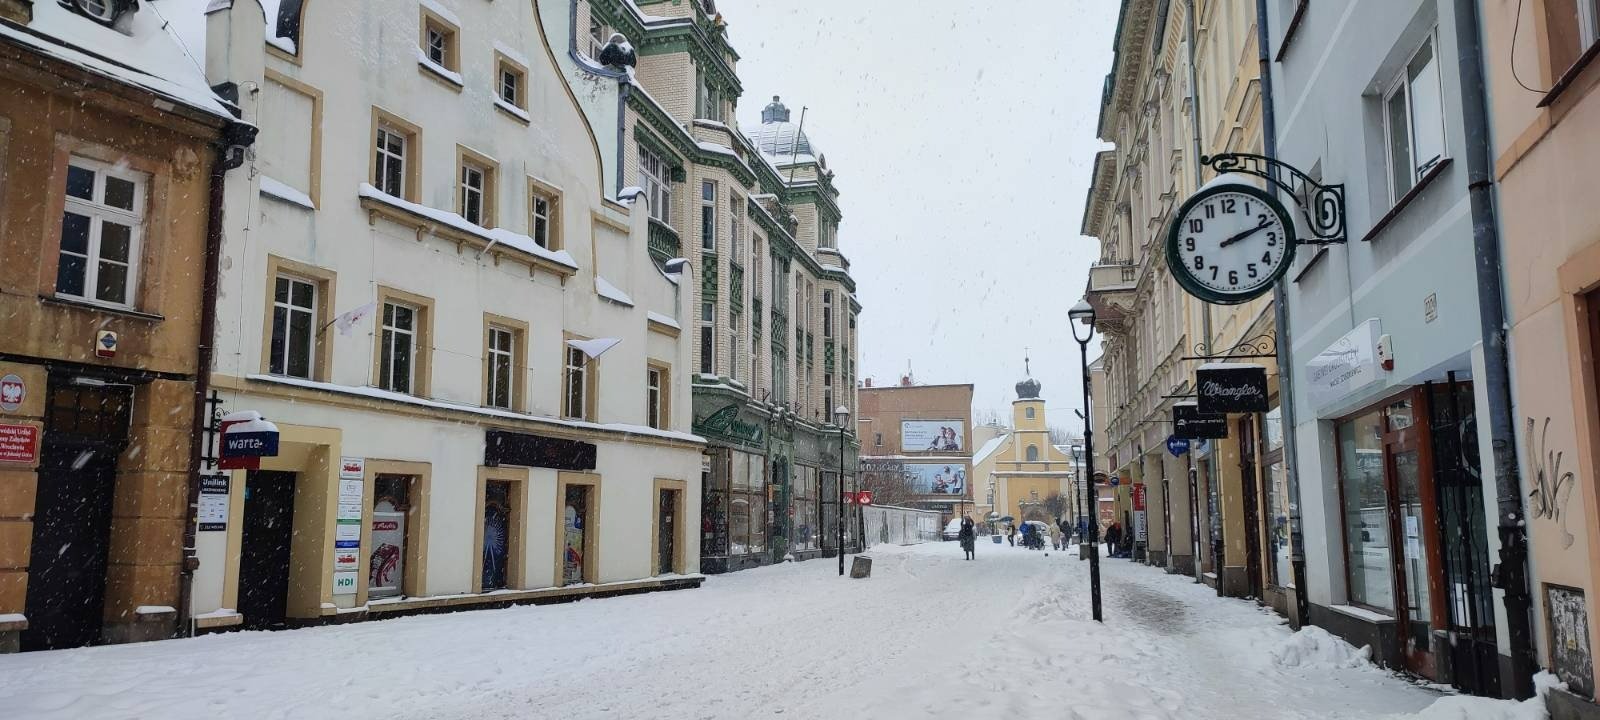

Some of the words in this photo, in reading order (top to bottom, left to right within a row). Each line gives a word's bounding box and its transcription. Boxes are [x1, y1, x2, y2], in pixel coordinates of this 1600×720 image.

[1205, 205, 1214, 218] 11
[1221, 199, 1236, 213] 12
[1245, 202, 1250, 216] 1
[1189, 219, 1203, 233] 10
[1258, 214, 1271, 228] 2
[1186, 237, 1195, 252] 9
[1266, 232, 1276, 246] 3
[1194, 256, 1204, 270] 8
[1262, 251, 1271, 265] 4
[1209, 266, 1218, 280] 7
[1229, 271, 1238, 285] 6
[1247, 264, 1257, 278] 5
[1203, 381, 1261, 400] Wrangler
[229, 438, 260, 449] warta
[338, 578, 353, 586] HDI
